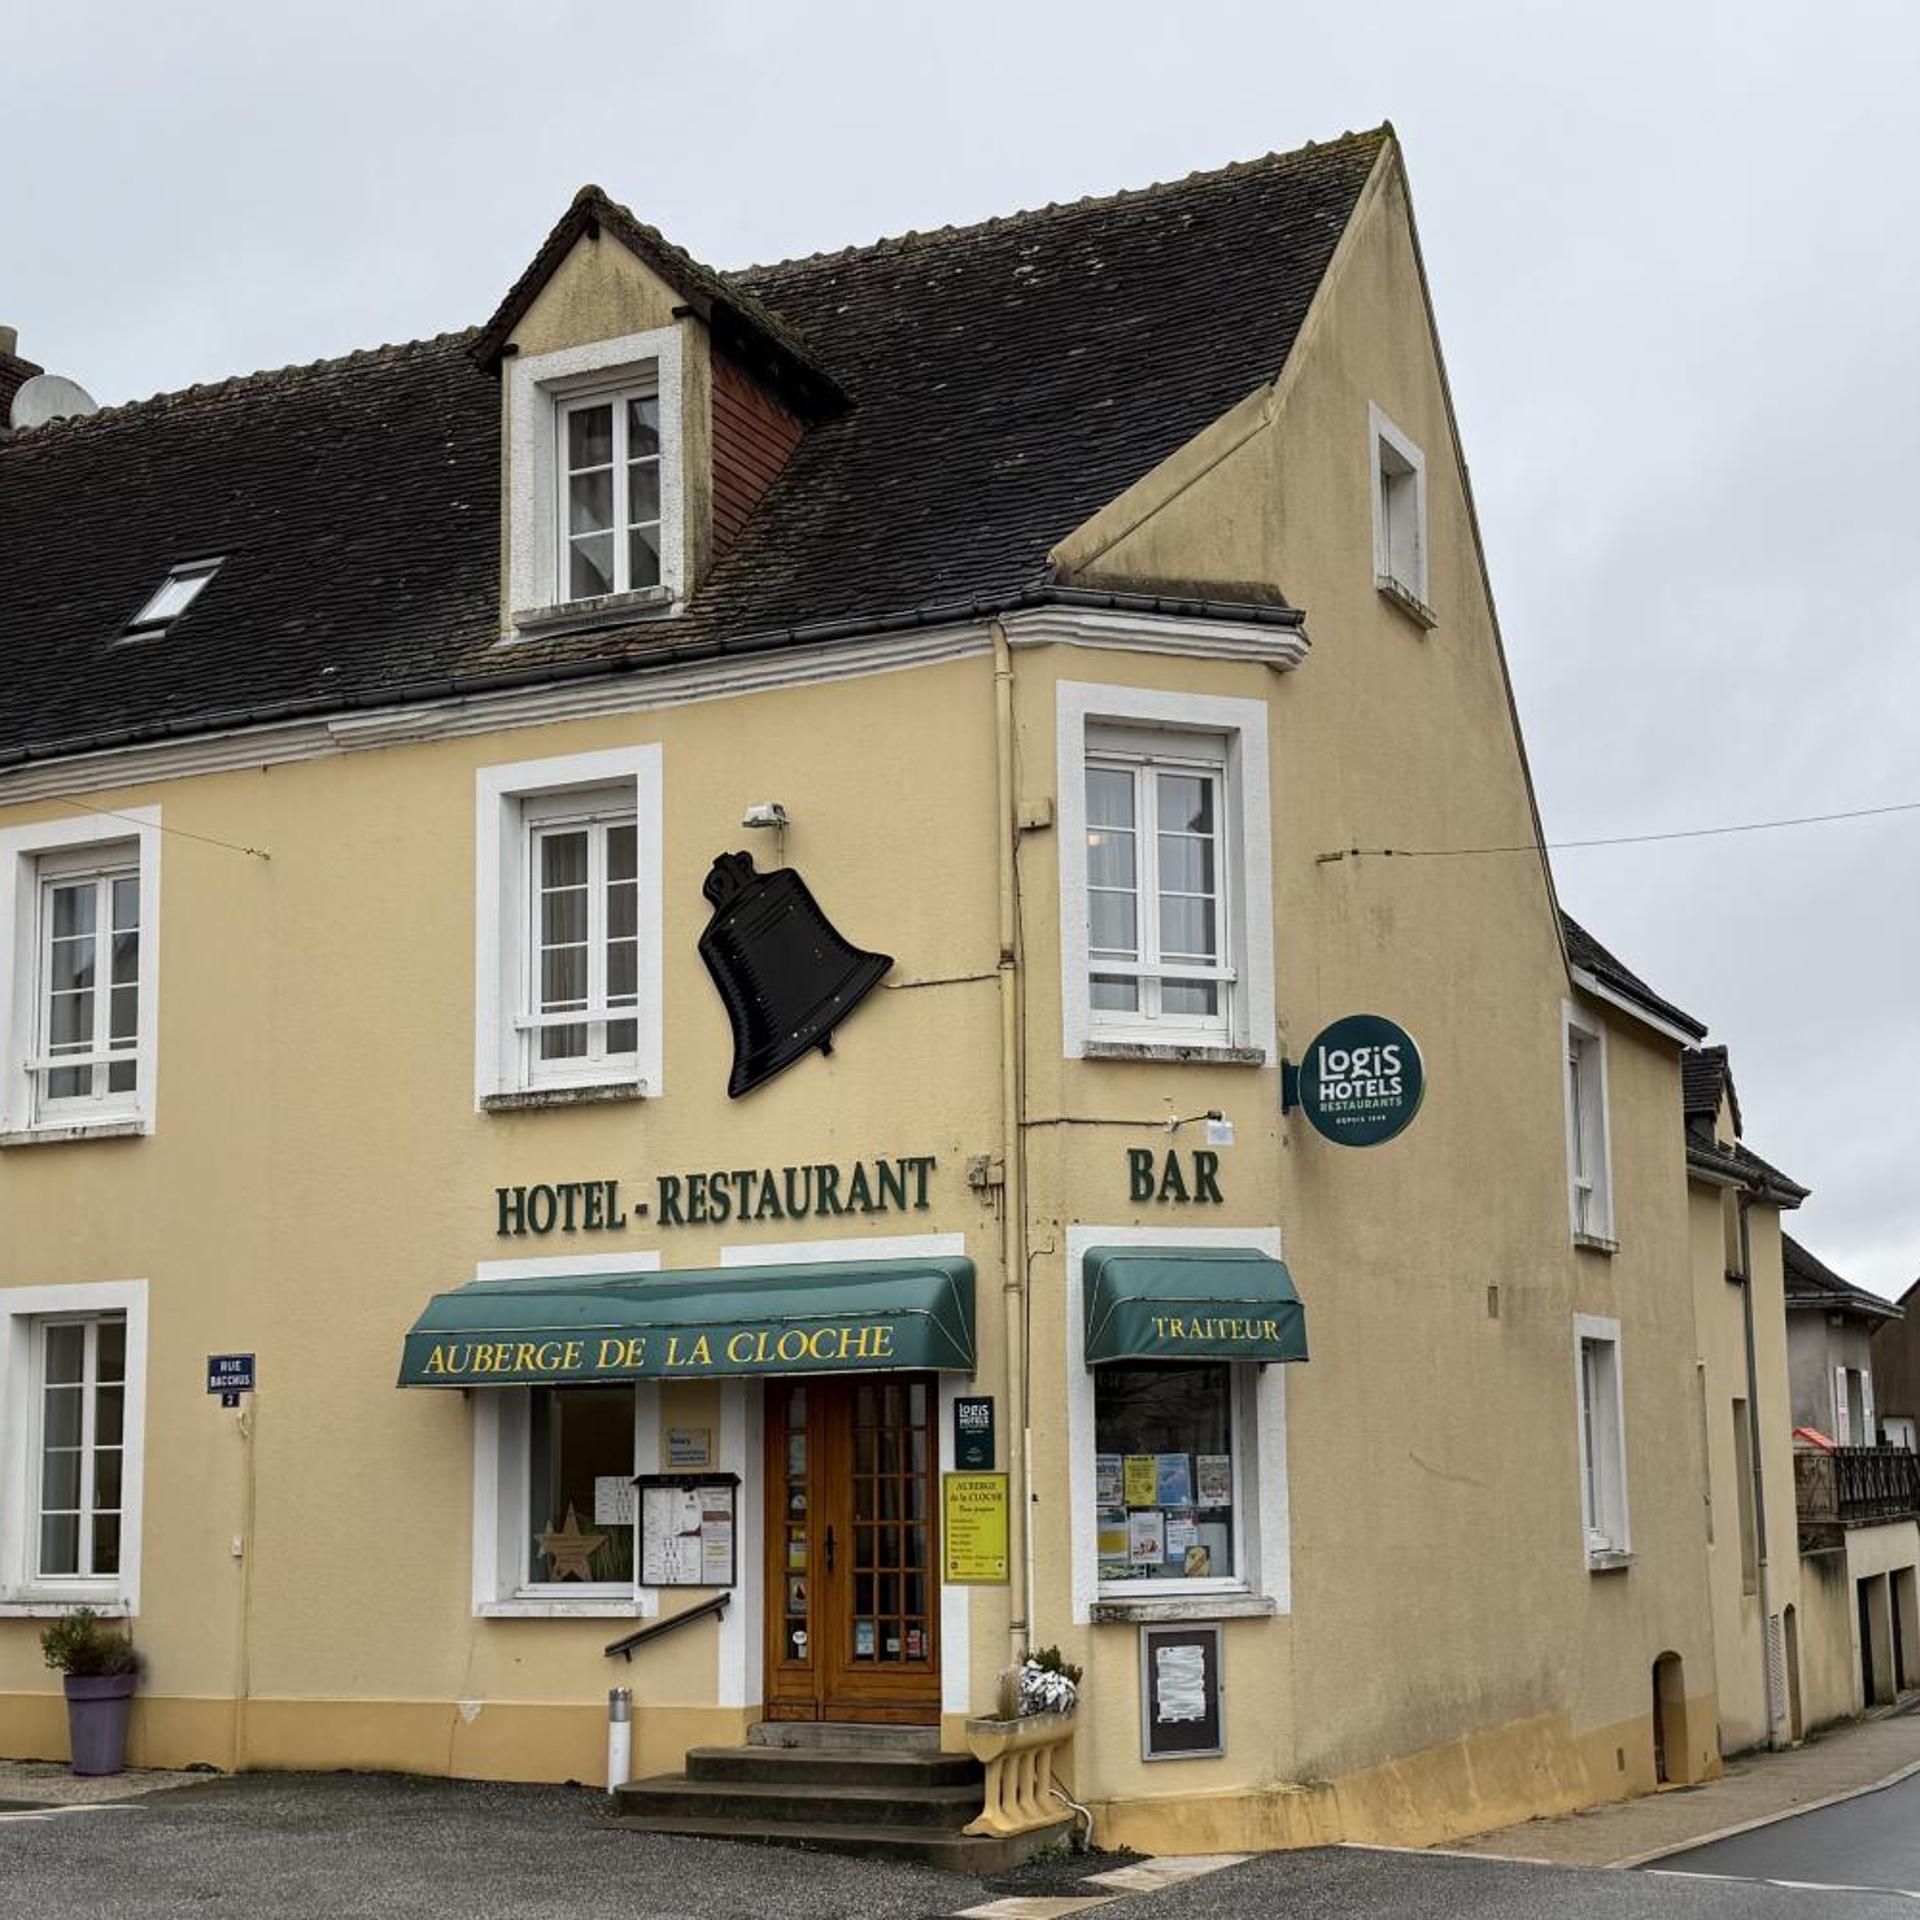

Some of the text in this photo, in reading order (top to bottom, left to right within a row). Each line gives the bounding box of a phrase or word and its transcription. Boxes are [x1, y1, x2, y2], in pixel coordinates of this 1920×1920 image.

[1320, 1077, 1402, 1101] HOTELS
[1320, 1097, 1402, 1112] RESTAURANTS
[1127, 1148, 1225, 1203] BAR
[496, 1180, 627, 1236] HOTEL
[656, 1155, 936, 1226] RESTAURANT
[1151, 1316, 1281, 1341] TRAITEUR
[422, 1326, 895, 1374] AUBERGE DE LA CLOCHE
[219, 1361, 242, 1372] RUE
[210, 1374, 251, 1387] BACCHUS
[956, 1481, 998, 1491] AUBERGE
